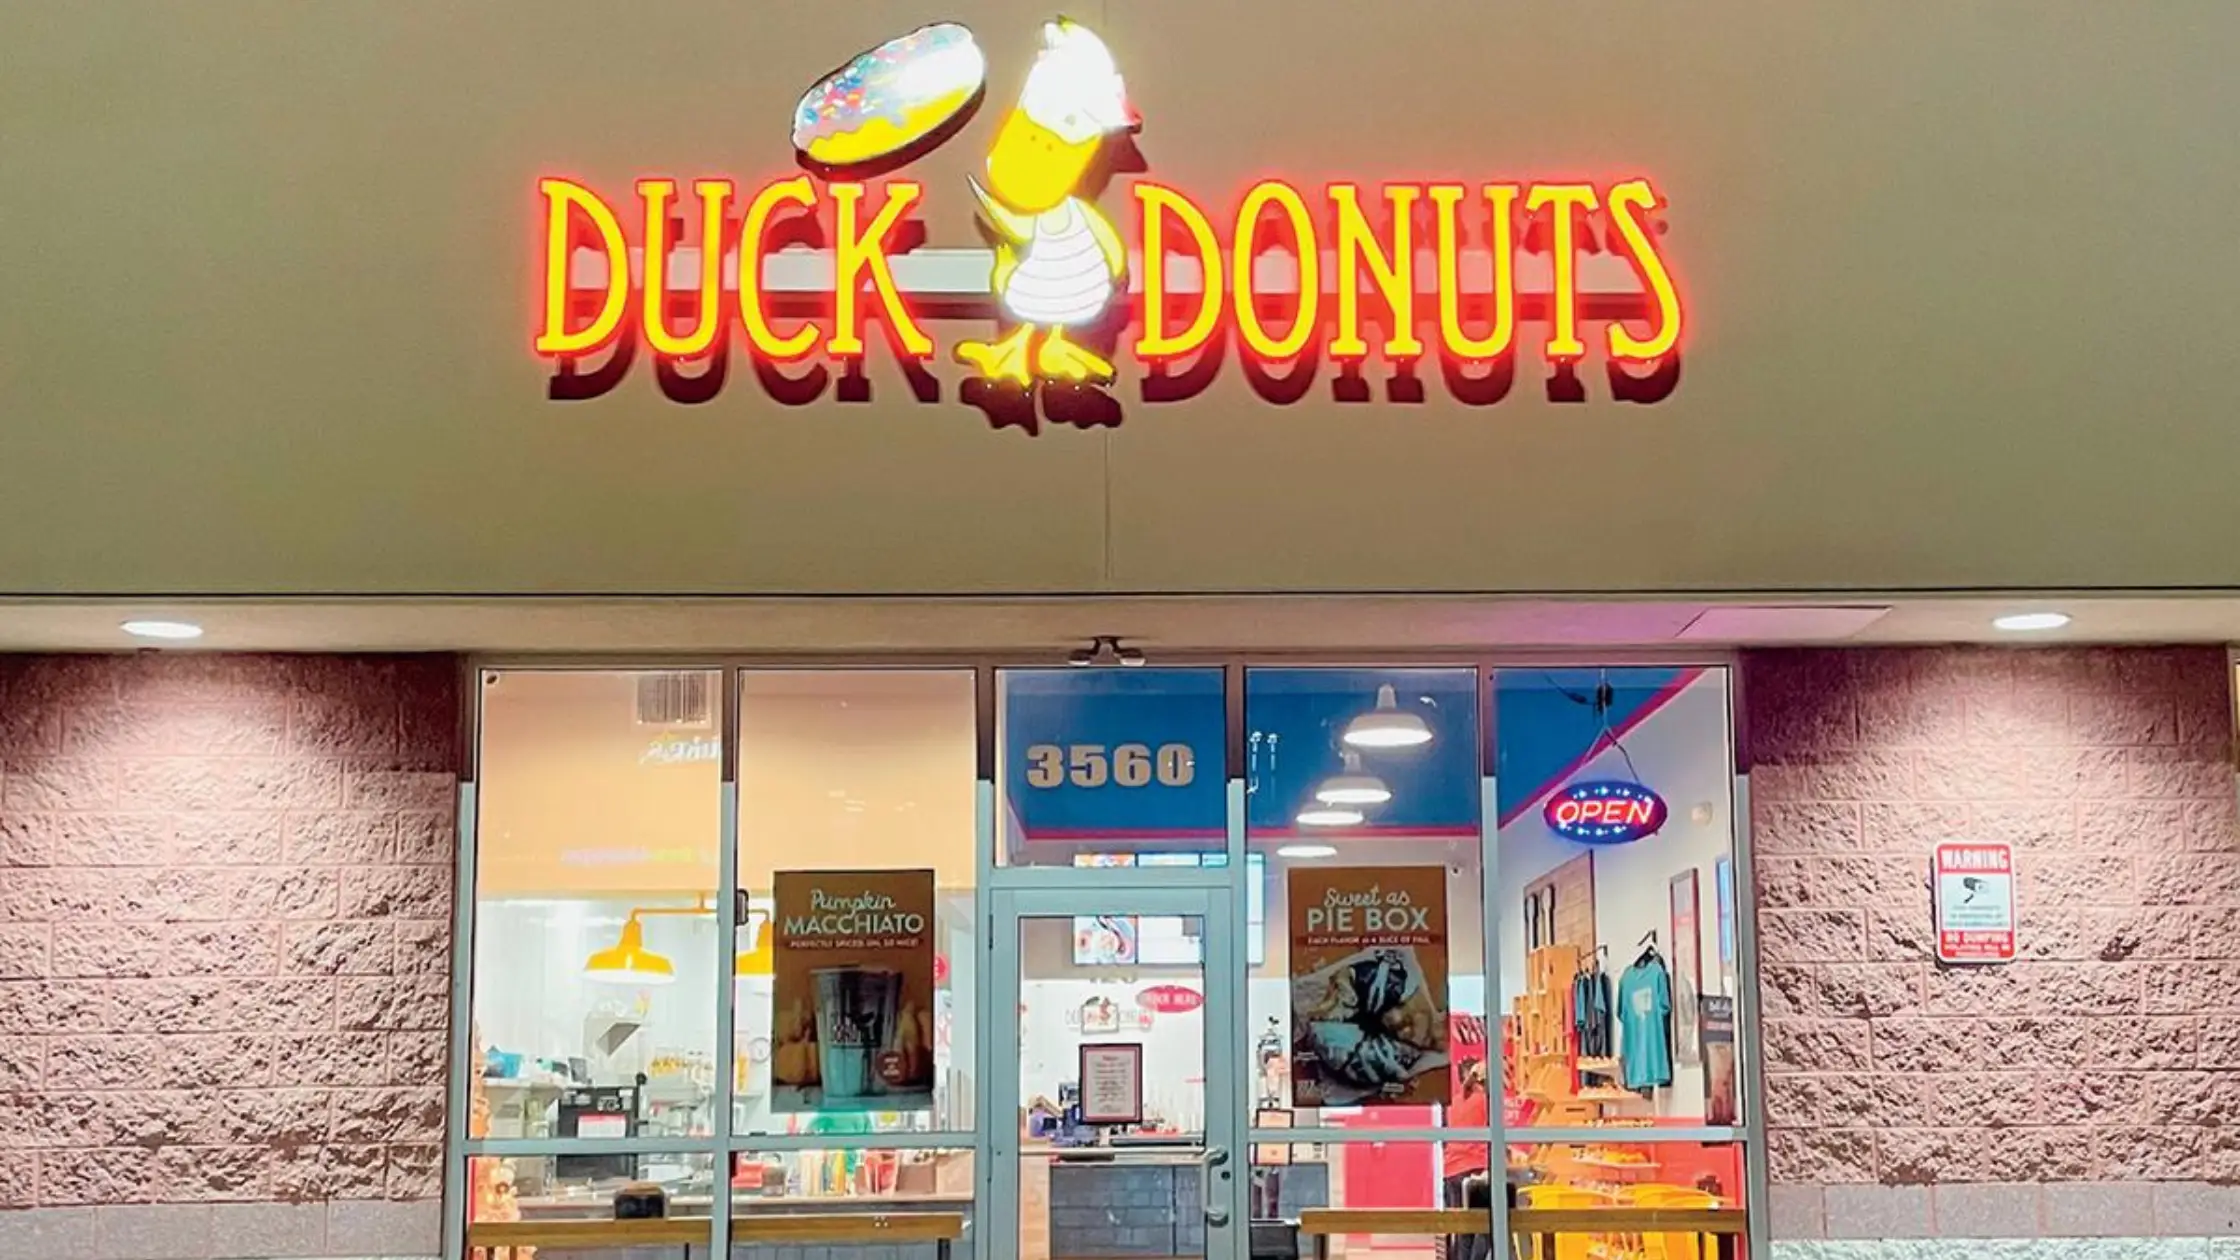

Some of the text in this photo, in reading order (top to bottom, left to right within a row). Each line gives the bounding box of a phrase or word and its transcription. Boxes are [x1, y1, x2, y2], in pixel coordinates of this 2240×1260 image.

[536, 175, 1682, 360] DUCK DONUTS
[1026, 743, 1195, 788] 3560
[1556, 799, 1654, 824] OPEN
[1941, 849, 2009, 869] WARNING
[811, 888, 896, 918] Pumpkin
[1324, 883, 1411, 908] Sweet as
[783, 913, 925, 935] MACCHIATO
[1307, 907, 1430, 932] PIE BOX
